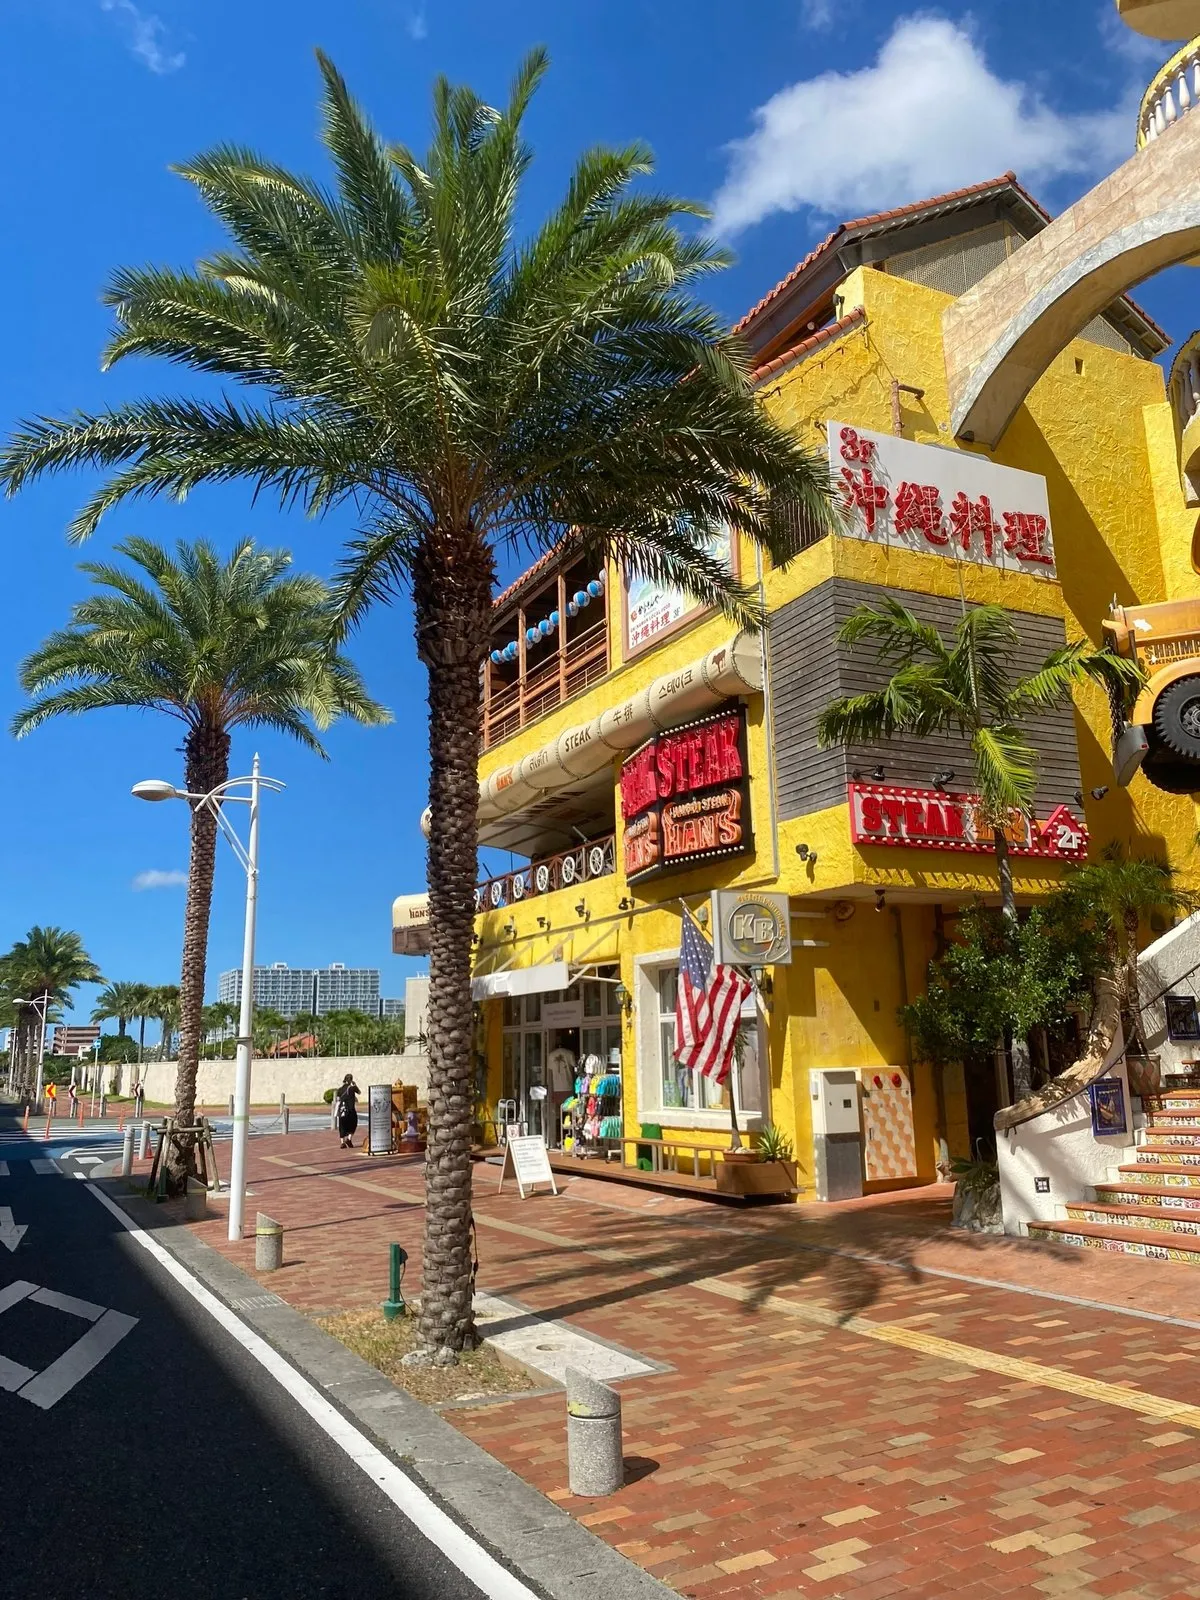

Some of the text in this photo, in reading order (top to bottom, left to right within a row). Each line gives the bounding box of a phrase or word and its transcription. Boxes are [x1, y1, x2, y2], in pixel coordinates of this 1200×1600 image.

[658, 669, 693, 699] 스테이크
[613, 703, 633, 725] 牛排
[565, 725, 592, 752] STEAK
[657, 716, 743, 798] STEAK
[661, 789, 742, 857] HAN'S
[861, 797, 965, 838] STEAK
[1057, 824, 1082, 849] 2F
[733, 913, 774, 944] KB
